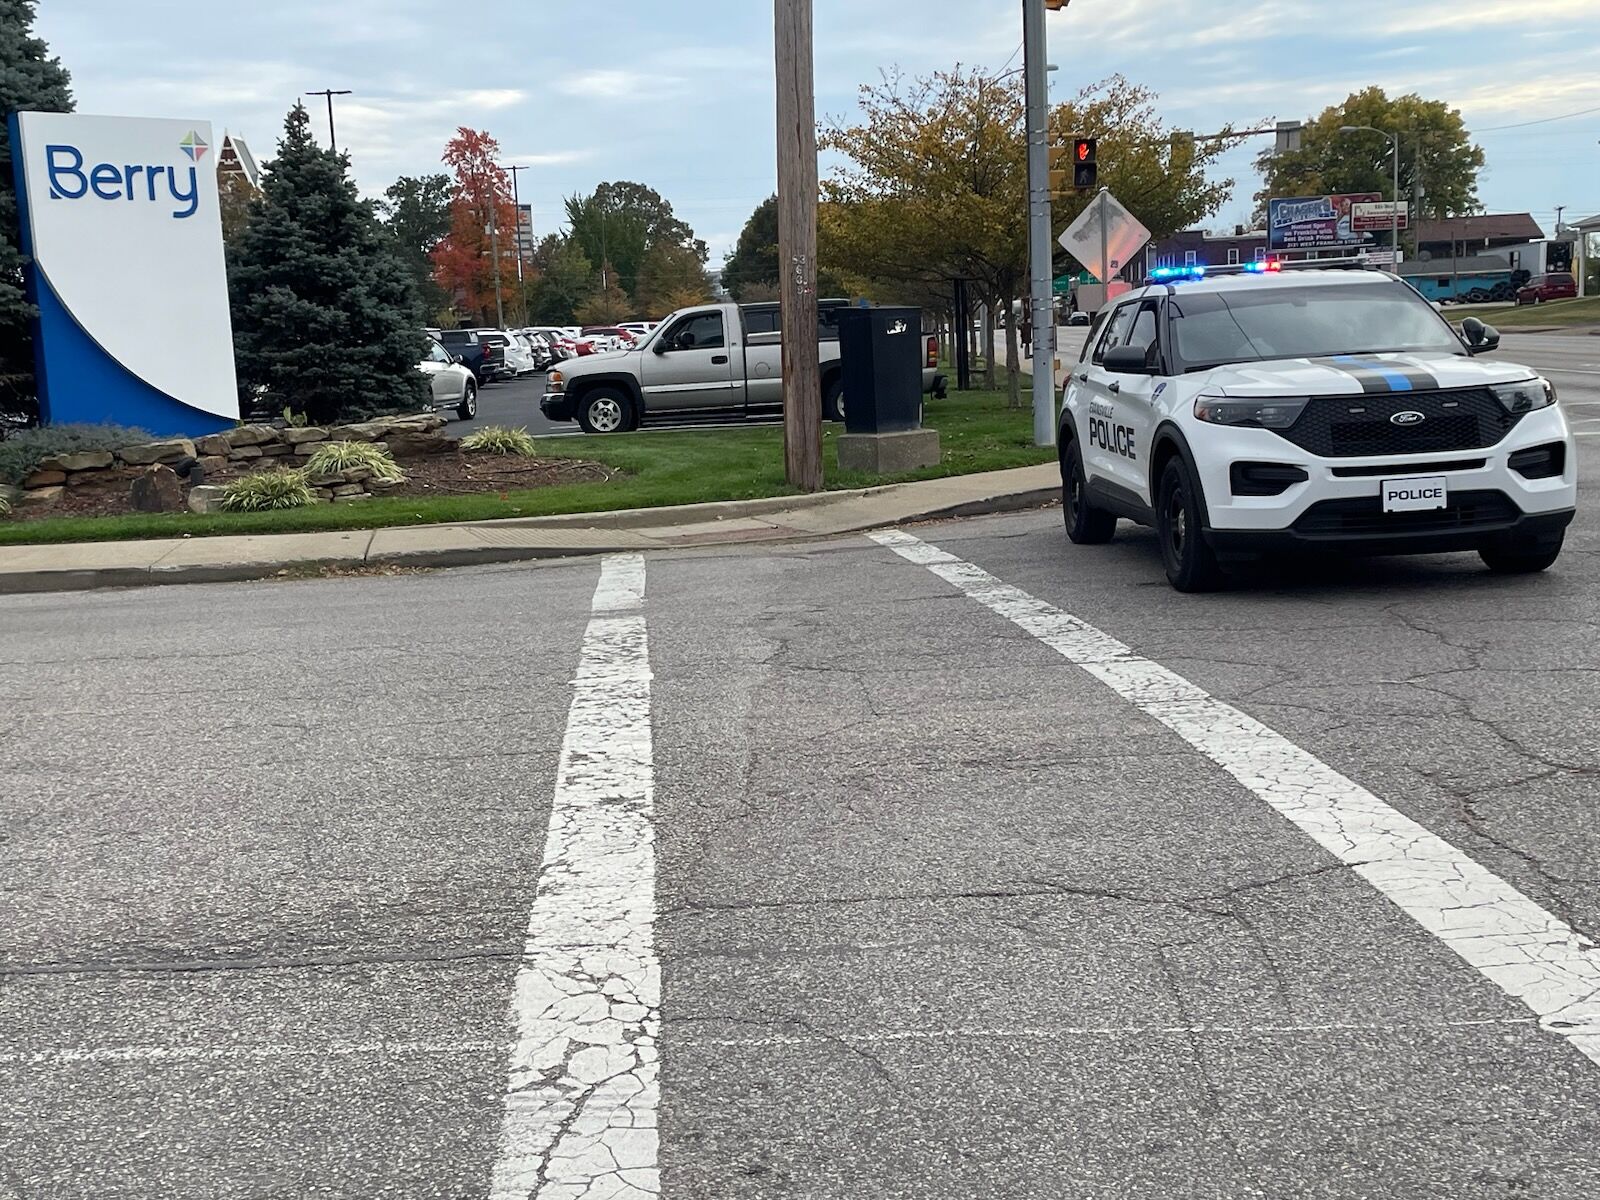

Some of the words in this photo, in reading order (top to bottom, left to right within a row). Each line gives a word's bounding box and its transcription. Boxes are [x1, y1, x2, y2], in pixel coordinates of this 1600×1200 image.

[46, 145, 198, 218] Berry
[1089, 417, 1136, 460] POLICE
[1388, 488, 1442, 501] POLICE
